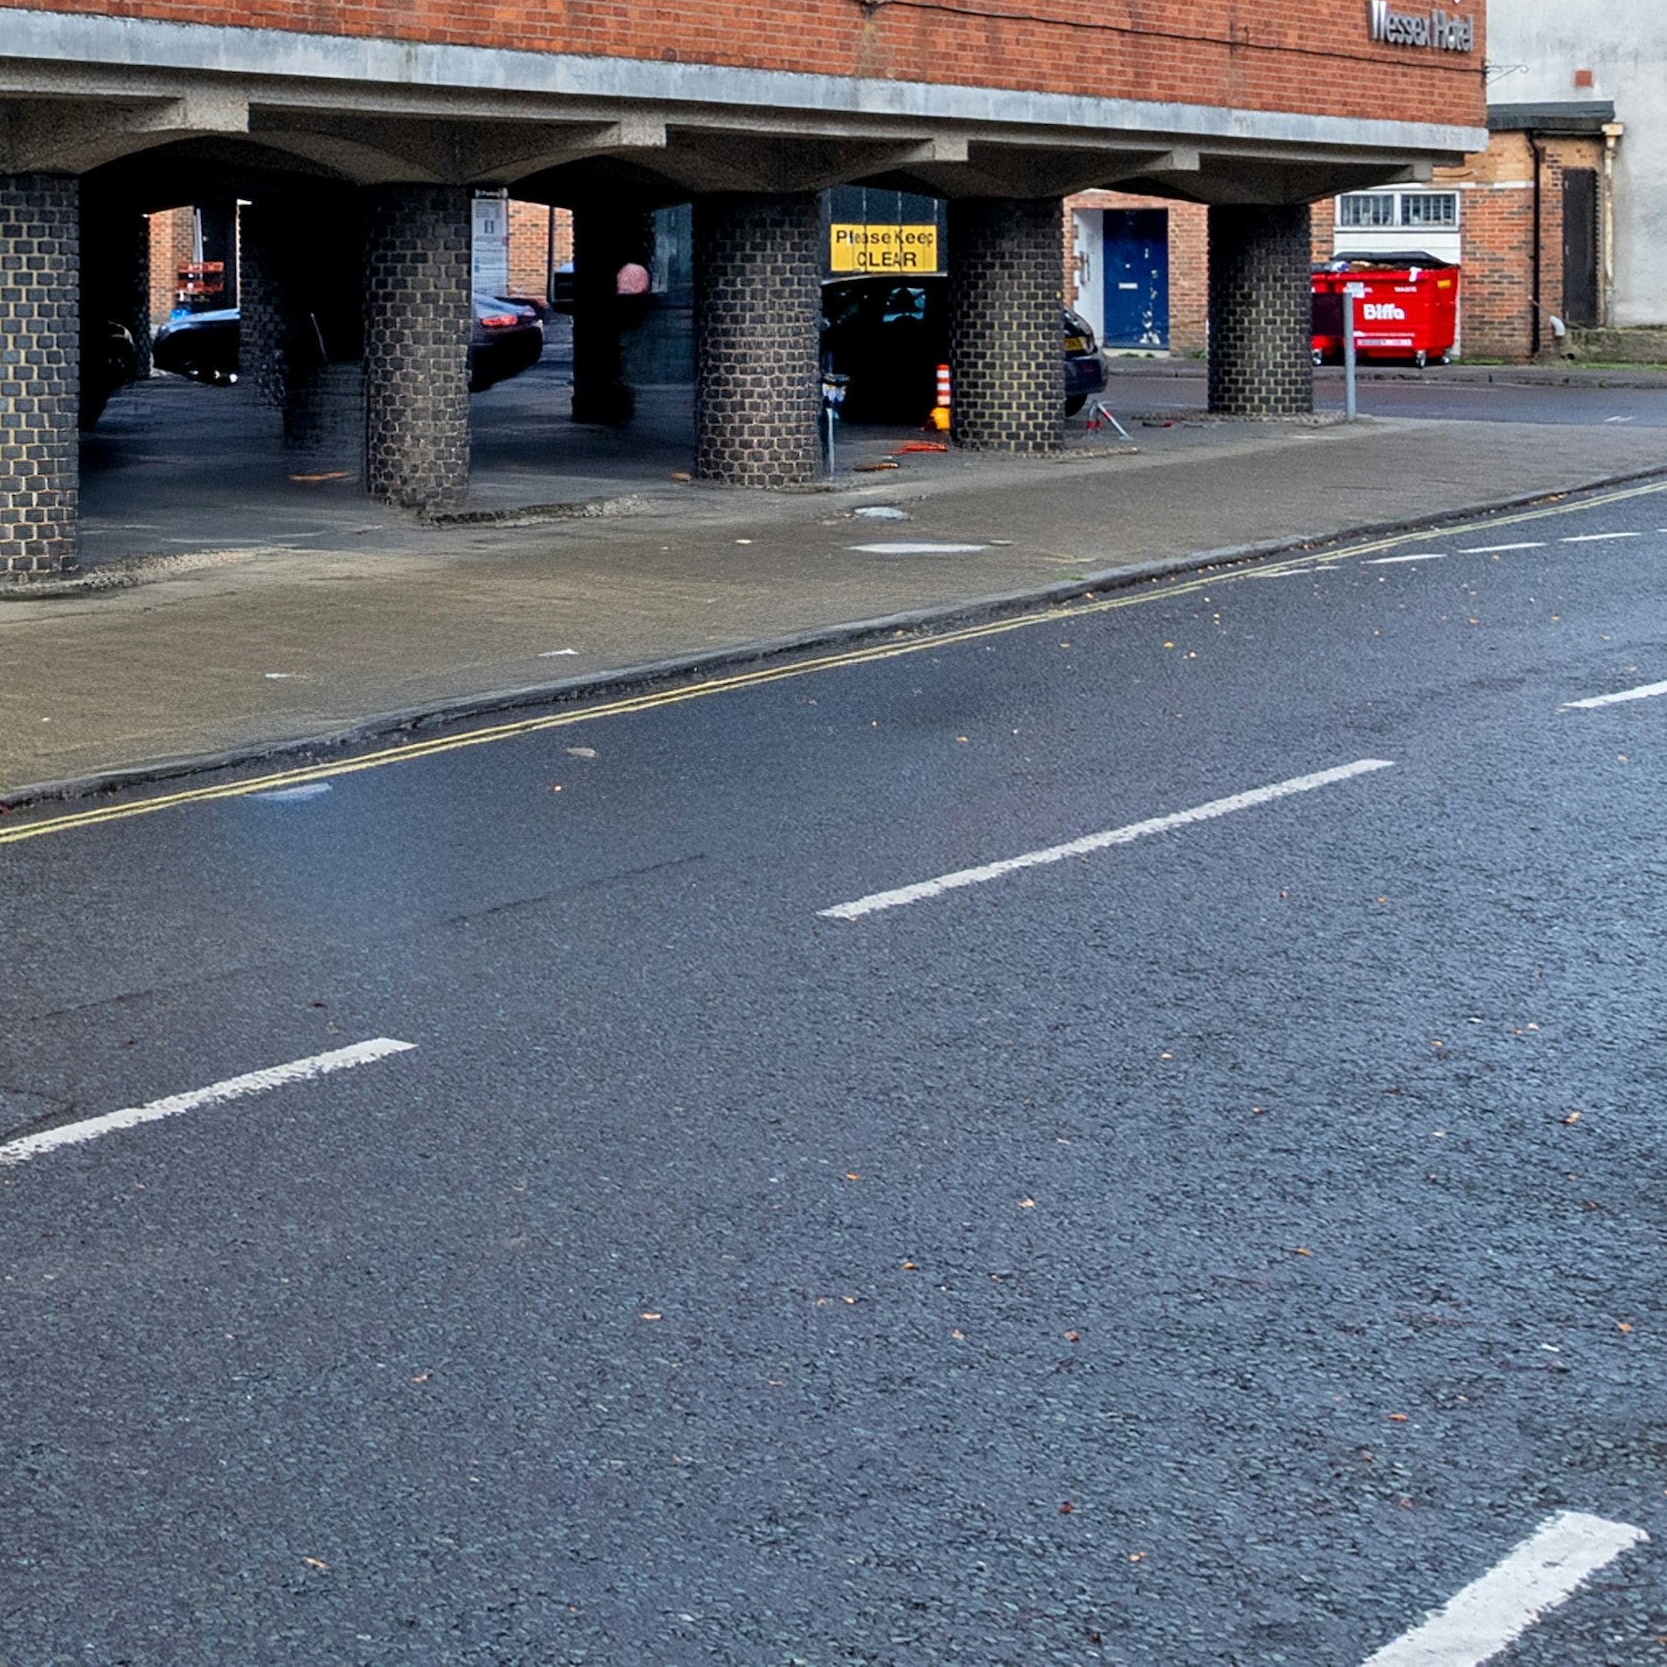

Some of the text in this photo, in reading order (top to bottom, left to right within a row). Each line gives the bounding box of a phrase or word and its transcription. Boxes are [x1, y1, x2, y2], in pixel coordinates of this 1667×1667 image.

[1431, 8, 1474, 51] Hotel
[836, 228, 933, 247] Please Keep
[857, 251, 916, 266] CLEAR
[1363, 303, 1405, 320] Biffa
